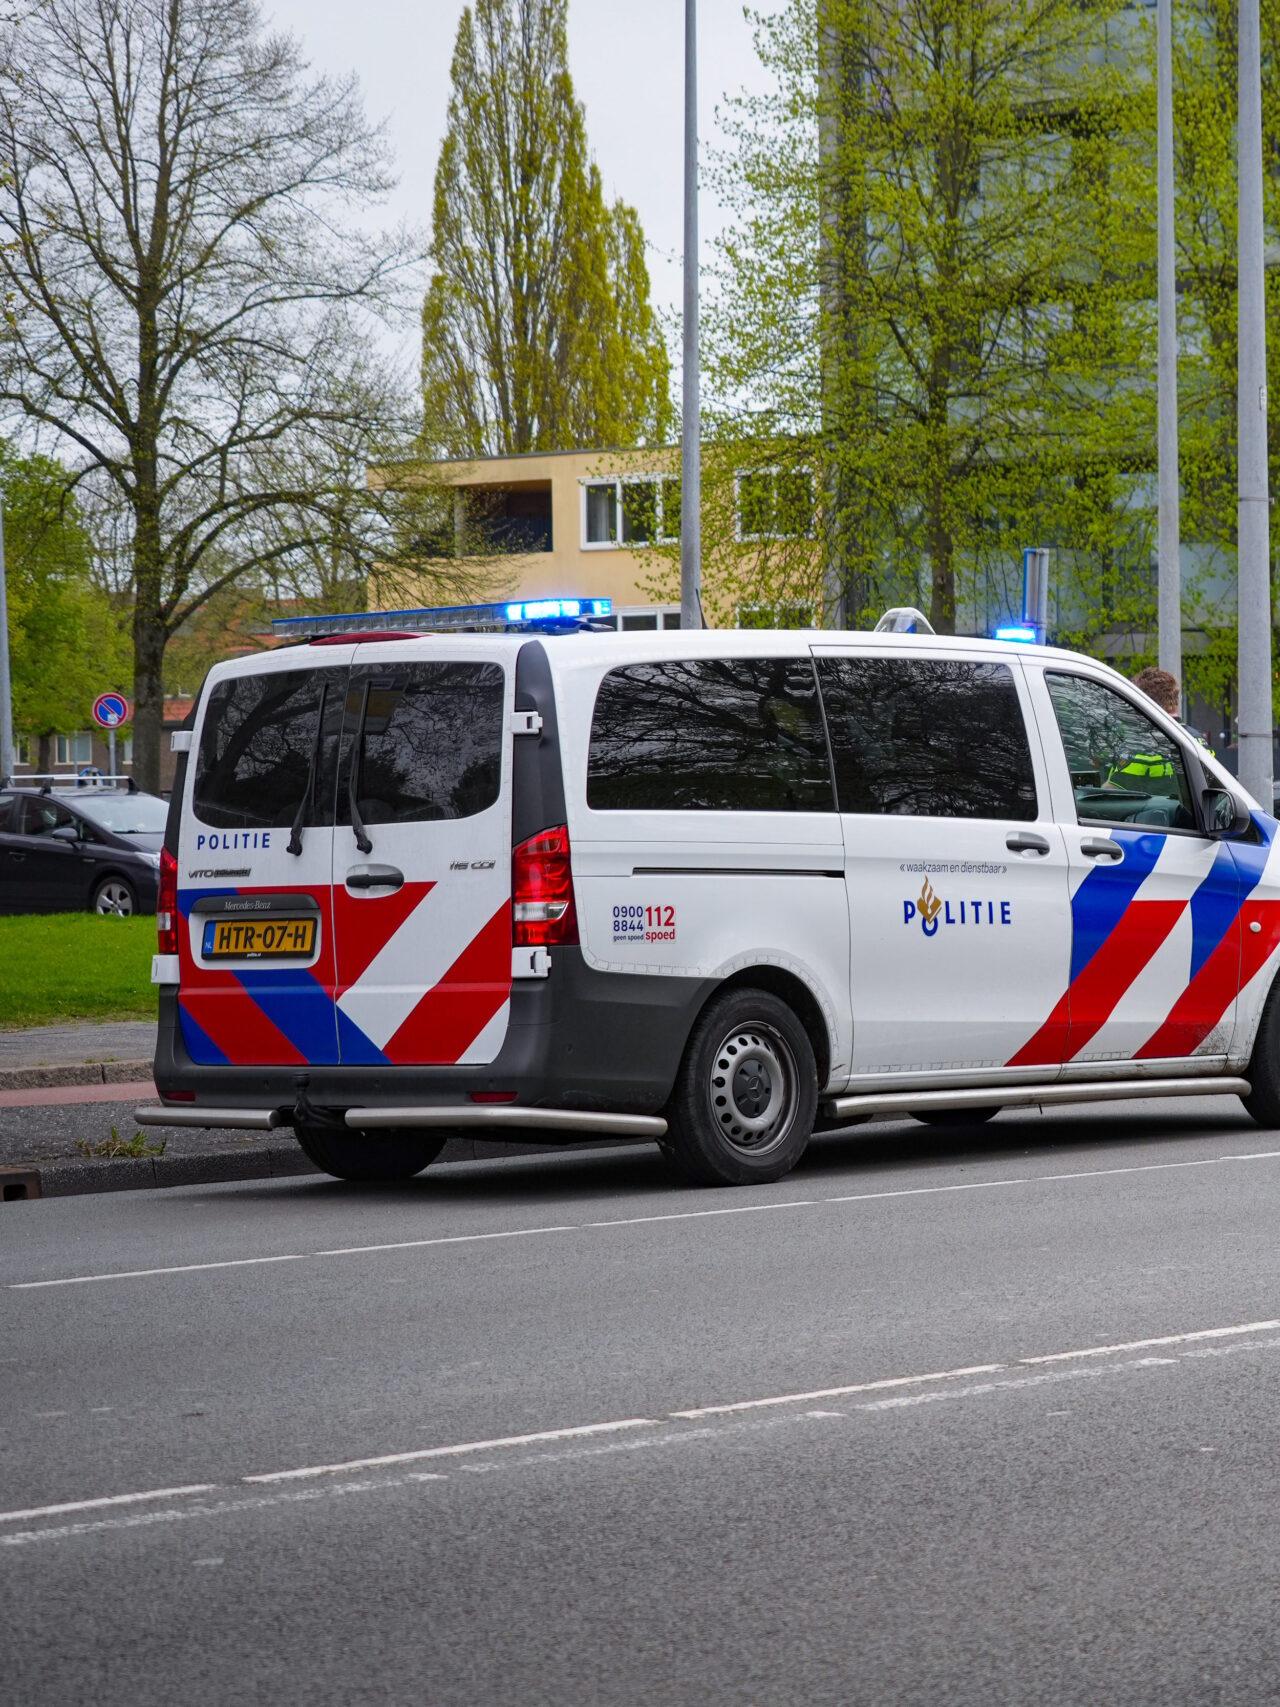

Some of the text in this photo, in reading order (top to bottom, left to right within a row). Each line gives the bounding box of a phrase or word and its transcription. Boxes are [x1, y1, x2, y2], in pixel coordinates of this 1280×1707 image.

[197, 832, 270, 850] POLITIE
[188, 869, 214, 879] VITO
[950, 864, 959, 873] en
[224, 901, 271, 911] Mercedes-Benz
[613, 906, 644, 918] 0900
[645, 906, 675, 927] 112
[903, 900, 1011, 937] POLITIE
[613, 920, 644, 931] 8844
[219, 925, 307, 950] HTR-07-H
[628, 934, 644, 942] spoed
[645, 929, 675, 943] spoed
